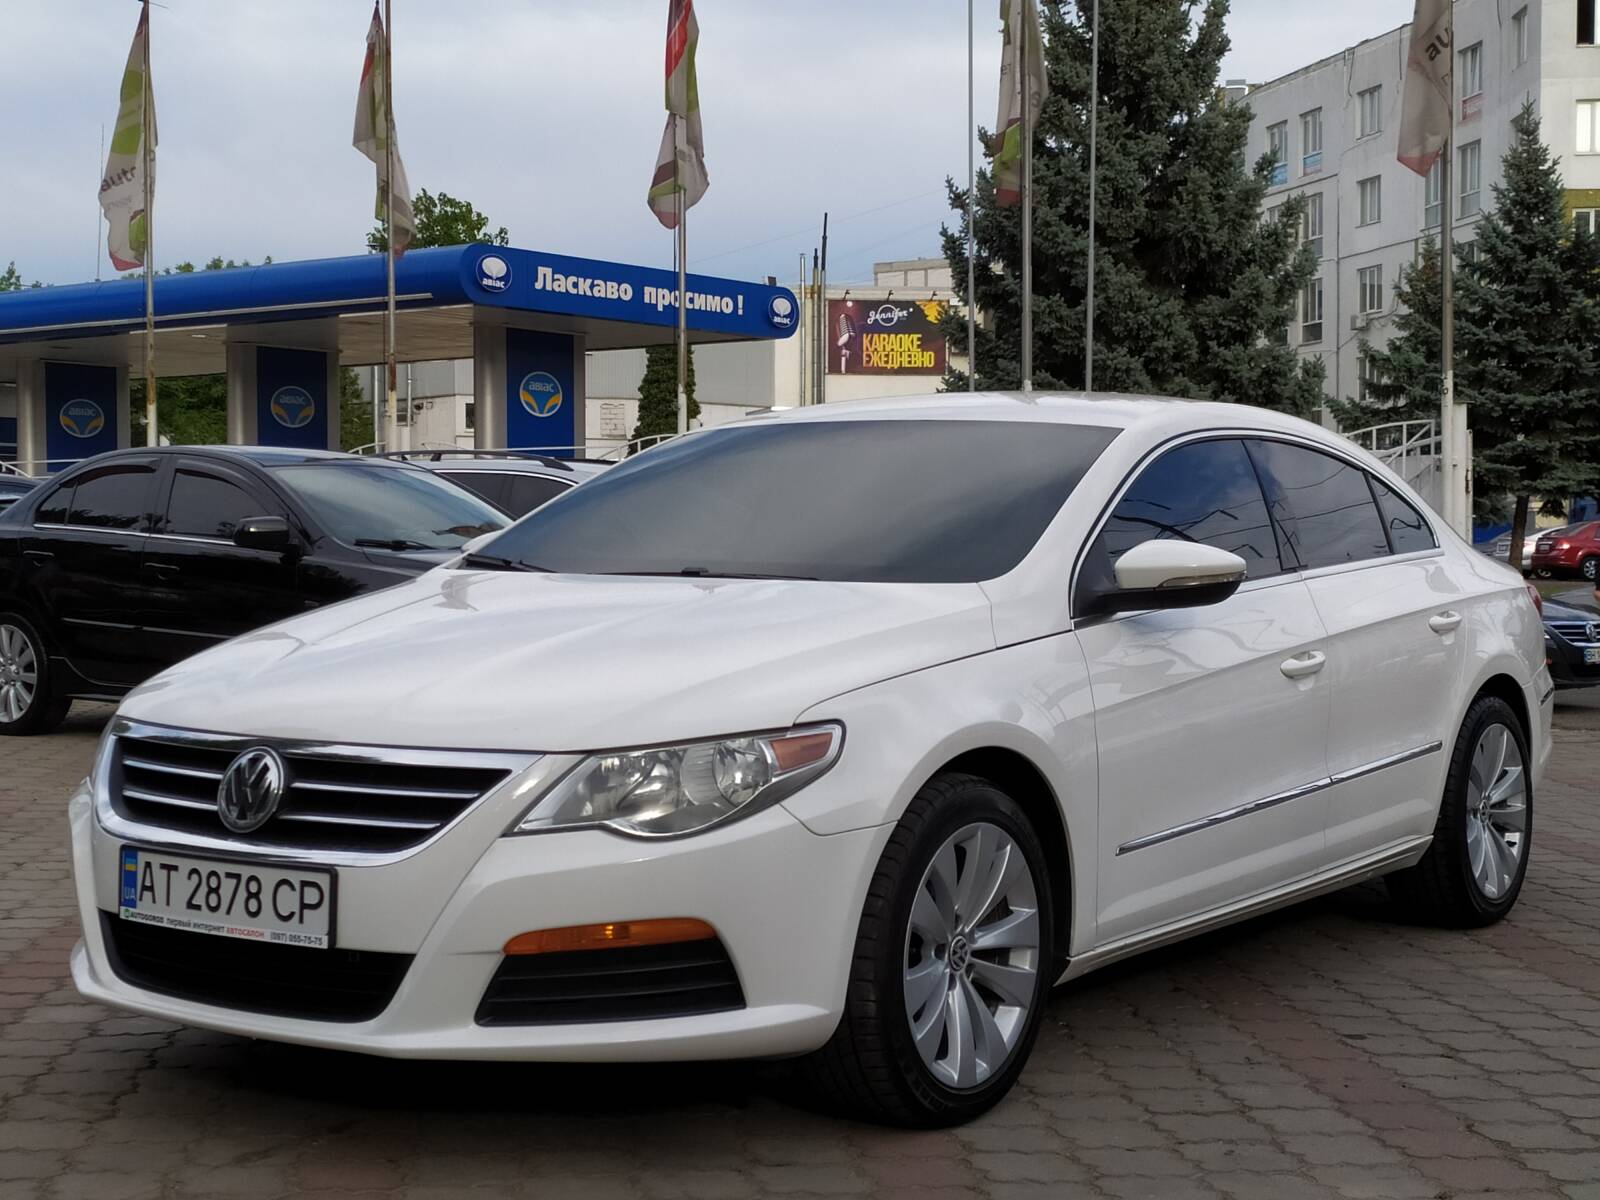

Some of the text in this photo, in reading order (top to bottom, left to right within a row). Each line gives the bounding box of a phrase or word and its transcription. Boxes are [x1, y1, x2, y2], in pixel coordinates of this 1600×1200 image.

[535, 266, 633, 301] Ласкаво
[863, 351, 935, 369] ЕЖЕДНЕВНО
[125, 887, 136, 900] UA
[139, 861, 325, 924] AT 2878 CP
